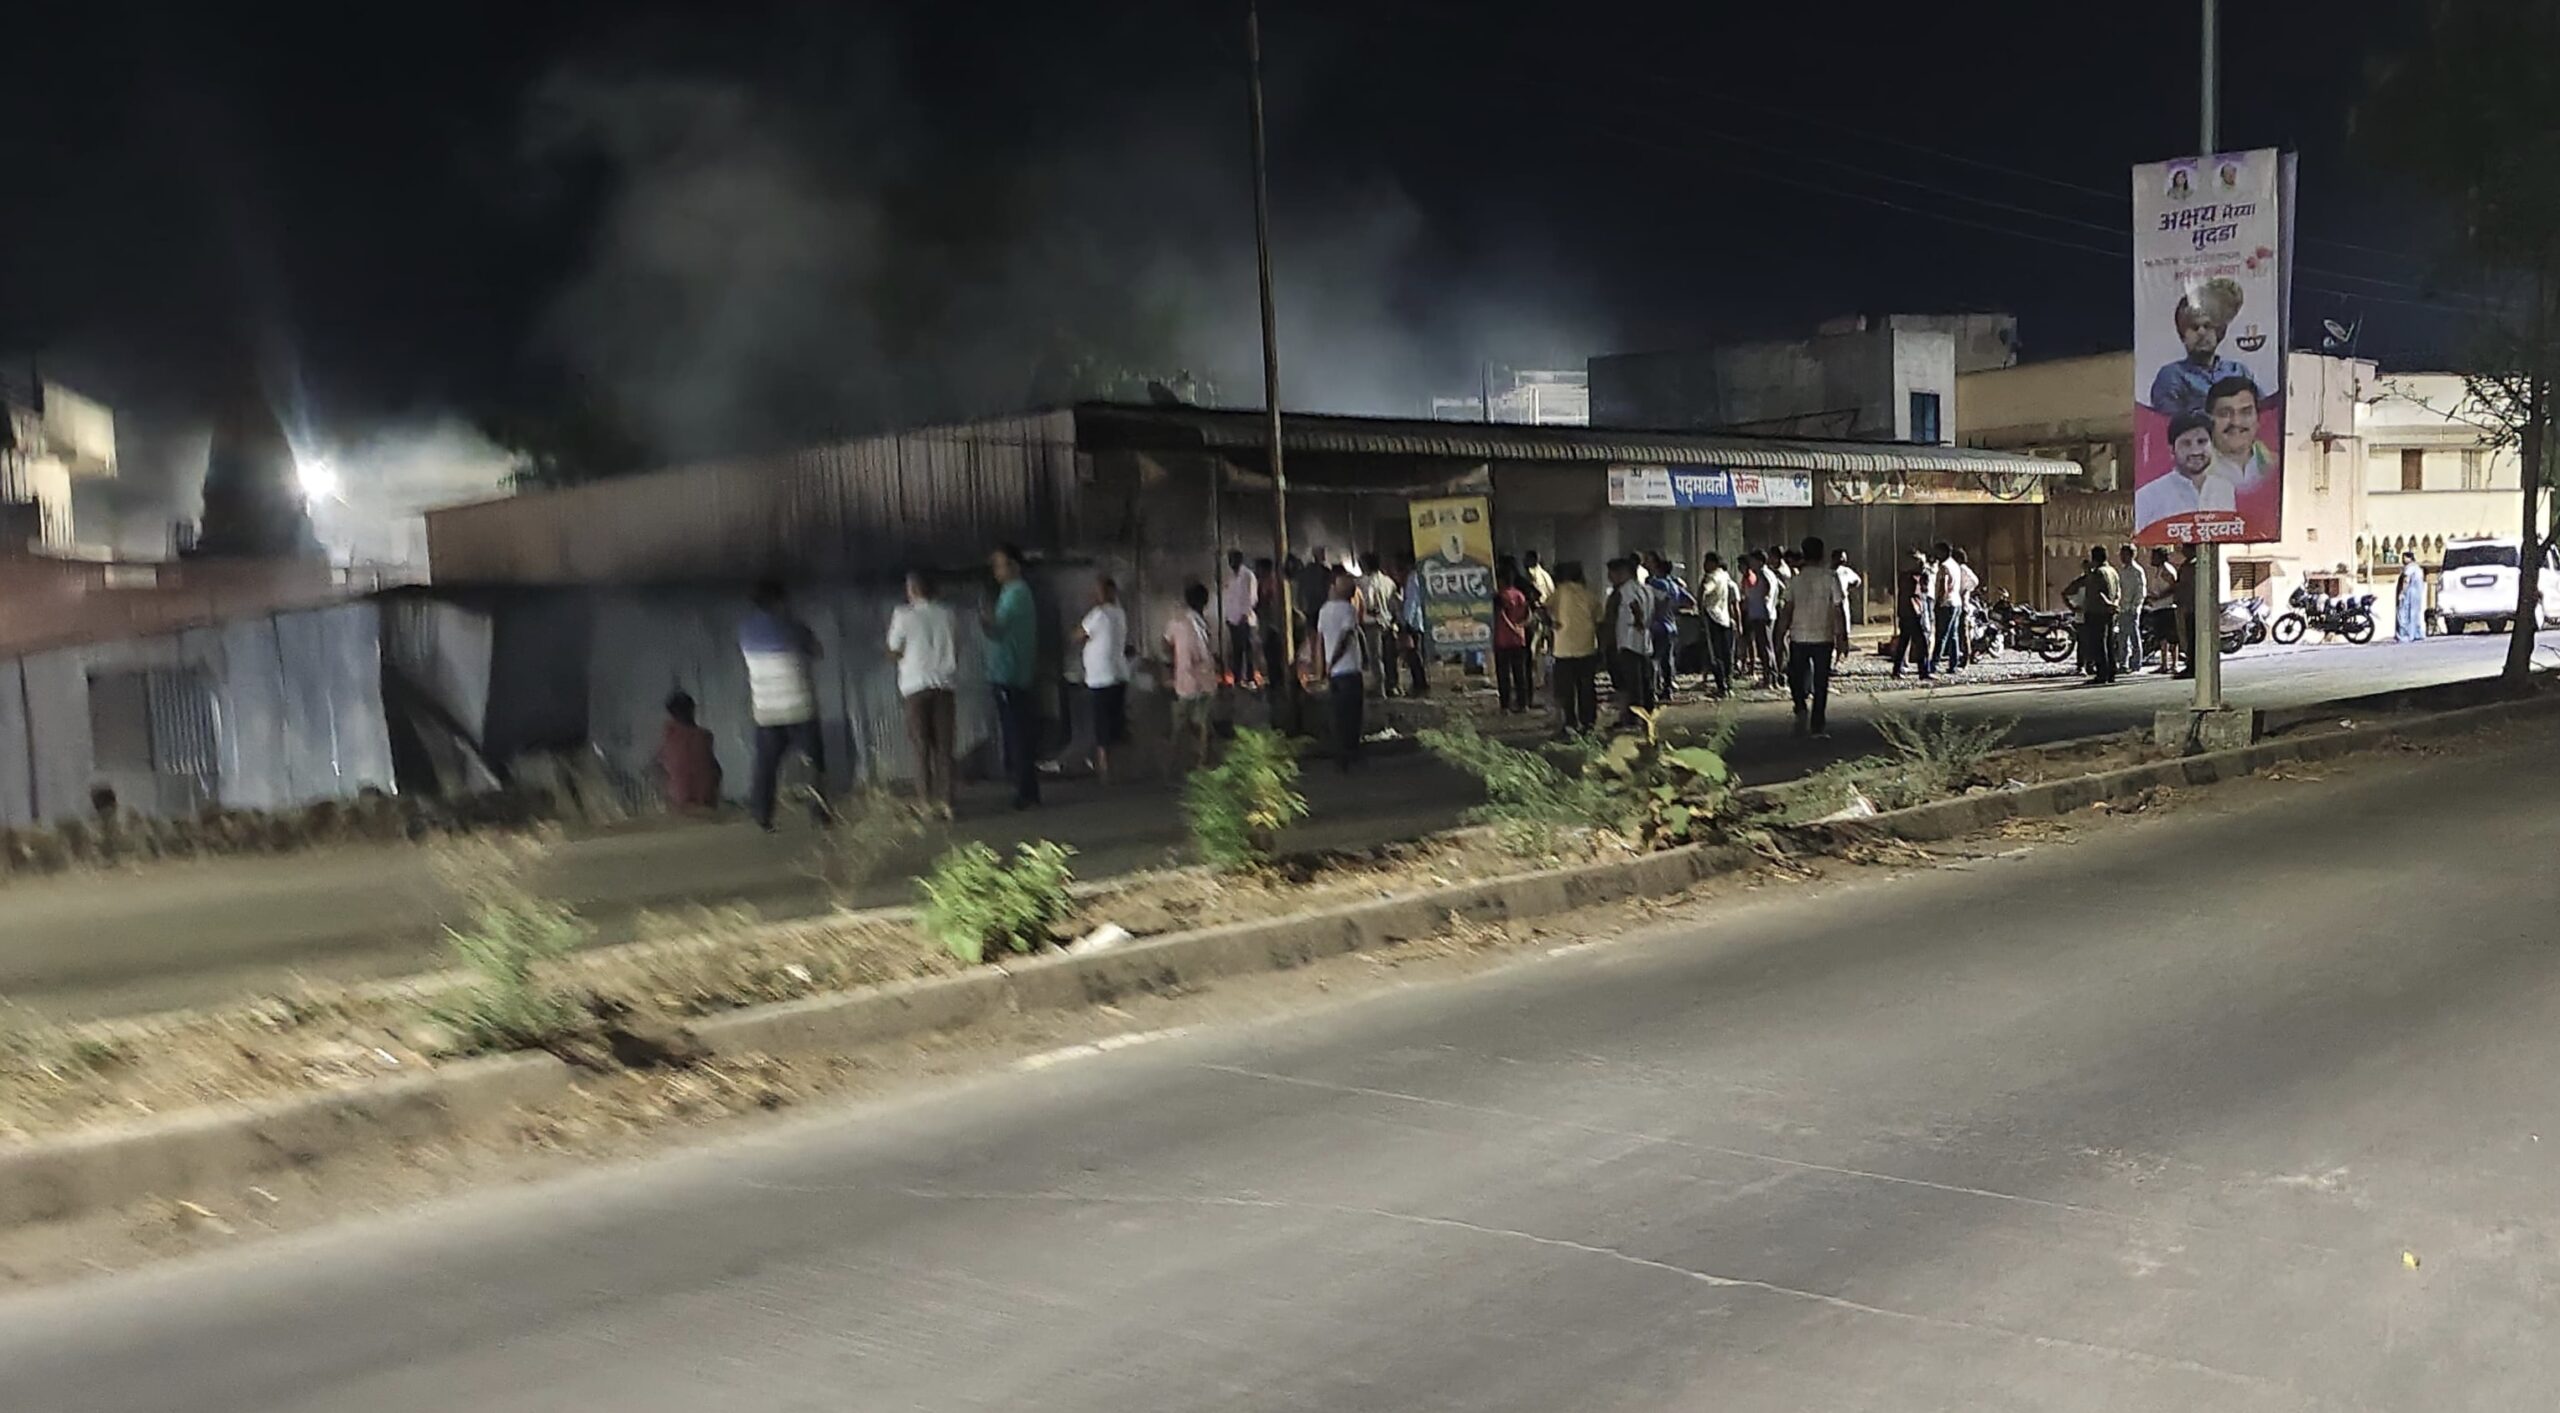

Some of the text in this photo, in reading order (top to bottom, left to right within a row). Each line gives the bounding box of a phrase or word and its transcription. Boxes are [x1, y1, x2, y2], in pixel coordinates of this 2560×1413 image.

[2158, 204, 2217, 231] अक्षय
[1735, 472, 1760, 494] सेल्स
[2196, 517, 2246, 542] सुरवसे
